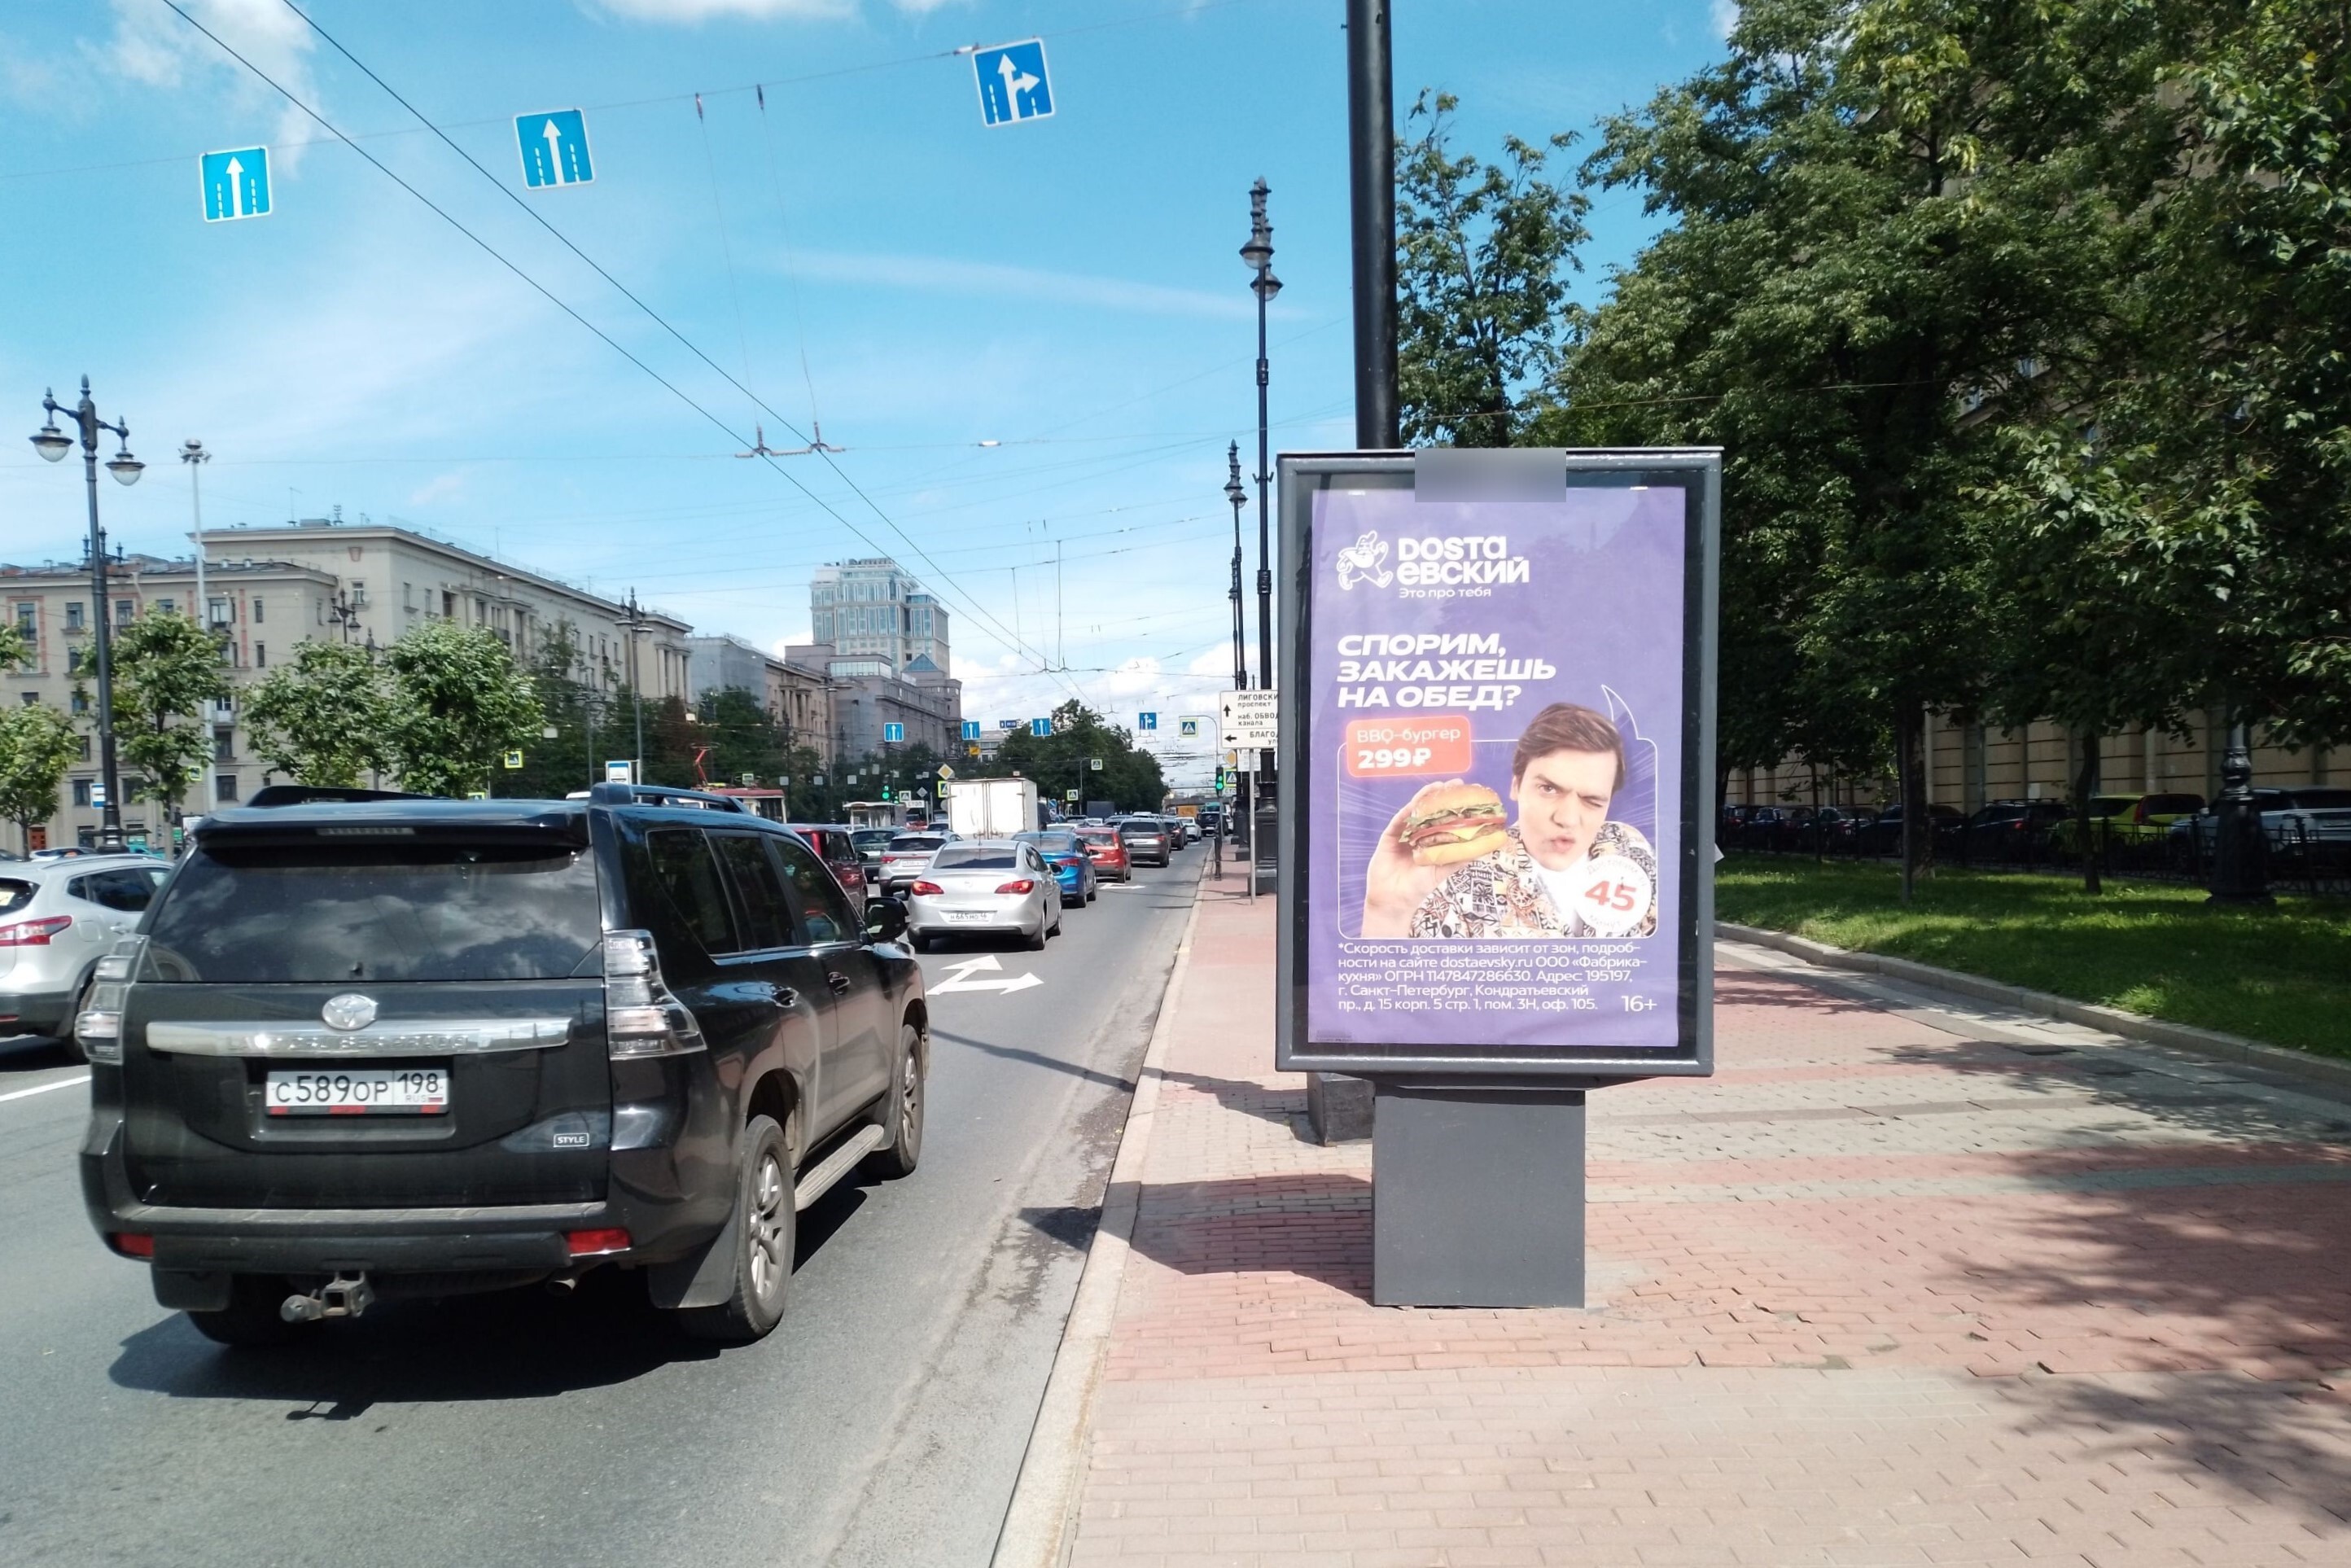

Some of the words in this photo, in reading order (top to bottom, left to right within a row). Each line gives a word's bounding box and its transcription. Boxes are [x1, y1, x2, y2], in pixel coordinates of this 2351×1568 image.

[1399, 588, 1426, 598] Это
[1429, 589, 1456, 599] про
[1459, 587, 1491, 598] тебя
[1337, 633, 1506, 657] СПОРИМ,
[1337, 659, 1556, 682] ЗАКАЖЕШЬ
[1337, 686, 1390, 707] НА
[1395, 685, 1522, 711] ОБЕД?
[1254, 712, 1278, 720] ОБВО
[1584, 880, 1637, 911] 45
[1410, 944, 1473, 956] доставки
[1476, 944, 1530, 954] зависит
[1534, 944, 1548, 954] от
[1551, 944, 1579, 954] зон,
[1582, 941, 1641, 956] подроб-
[1338, 959, 1377, 967] ности
[1380, 959, 1397, 967] на
[1399, 957, 1438, 968] сайте
[1440, 956, 1532, 970] dostaevsky.ru
[1535, 956, 1570, 967] ООО
[1572, 956, 1648, 970] «Фабрика-
[1338, 972, 1382, 984] кухня»
[1384, 970, 1424, 982] ОГРН
[1426, 970, 1534, 982] 1147847286630.
[1585, 970, 1633, 983] 195197,
[1338, 987, 1348, 996] г.
[1351, 984, 1473, 998] Санкт-Петербург,
[1475, 984, 1589, 998] Кондратьевский
[1338, 1001, 1361, 1013] пр.,
[1363, 1001, 1376, 1011] д.
[1378, 999, 1392, 1010] 15
[1394, 1001, 1430, 1013] корп.
[1434, 999, 1443, 1010] 5
[1445, 1001, 1470, 1013] стр.
[1473, 999, 1482, 1011] 1,
[1485, 1001, 1515, 1010] пом.
[1542, 999, 1568, 1012] оф.
[1571, 999, 1598, 1010] 105.
[1622, 996, 1657, 1012] 16+
[275, 1075, 389, 1103] С589ОР
[396, 1072, 439, 1094] 198
[405, 1094, 427, 1103] RUS
